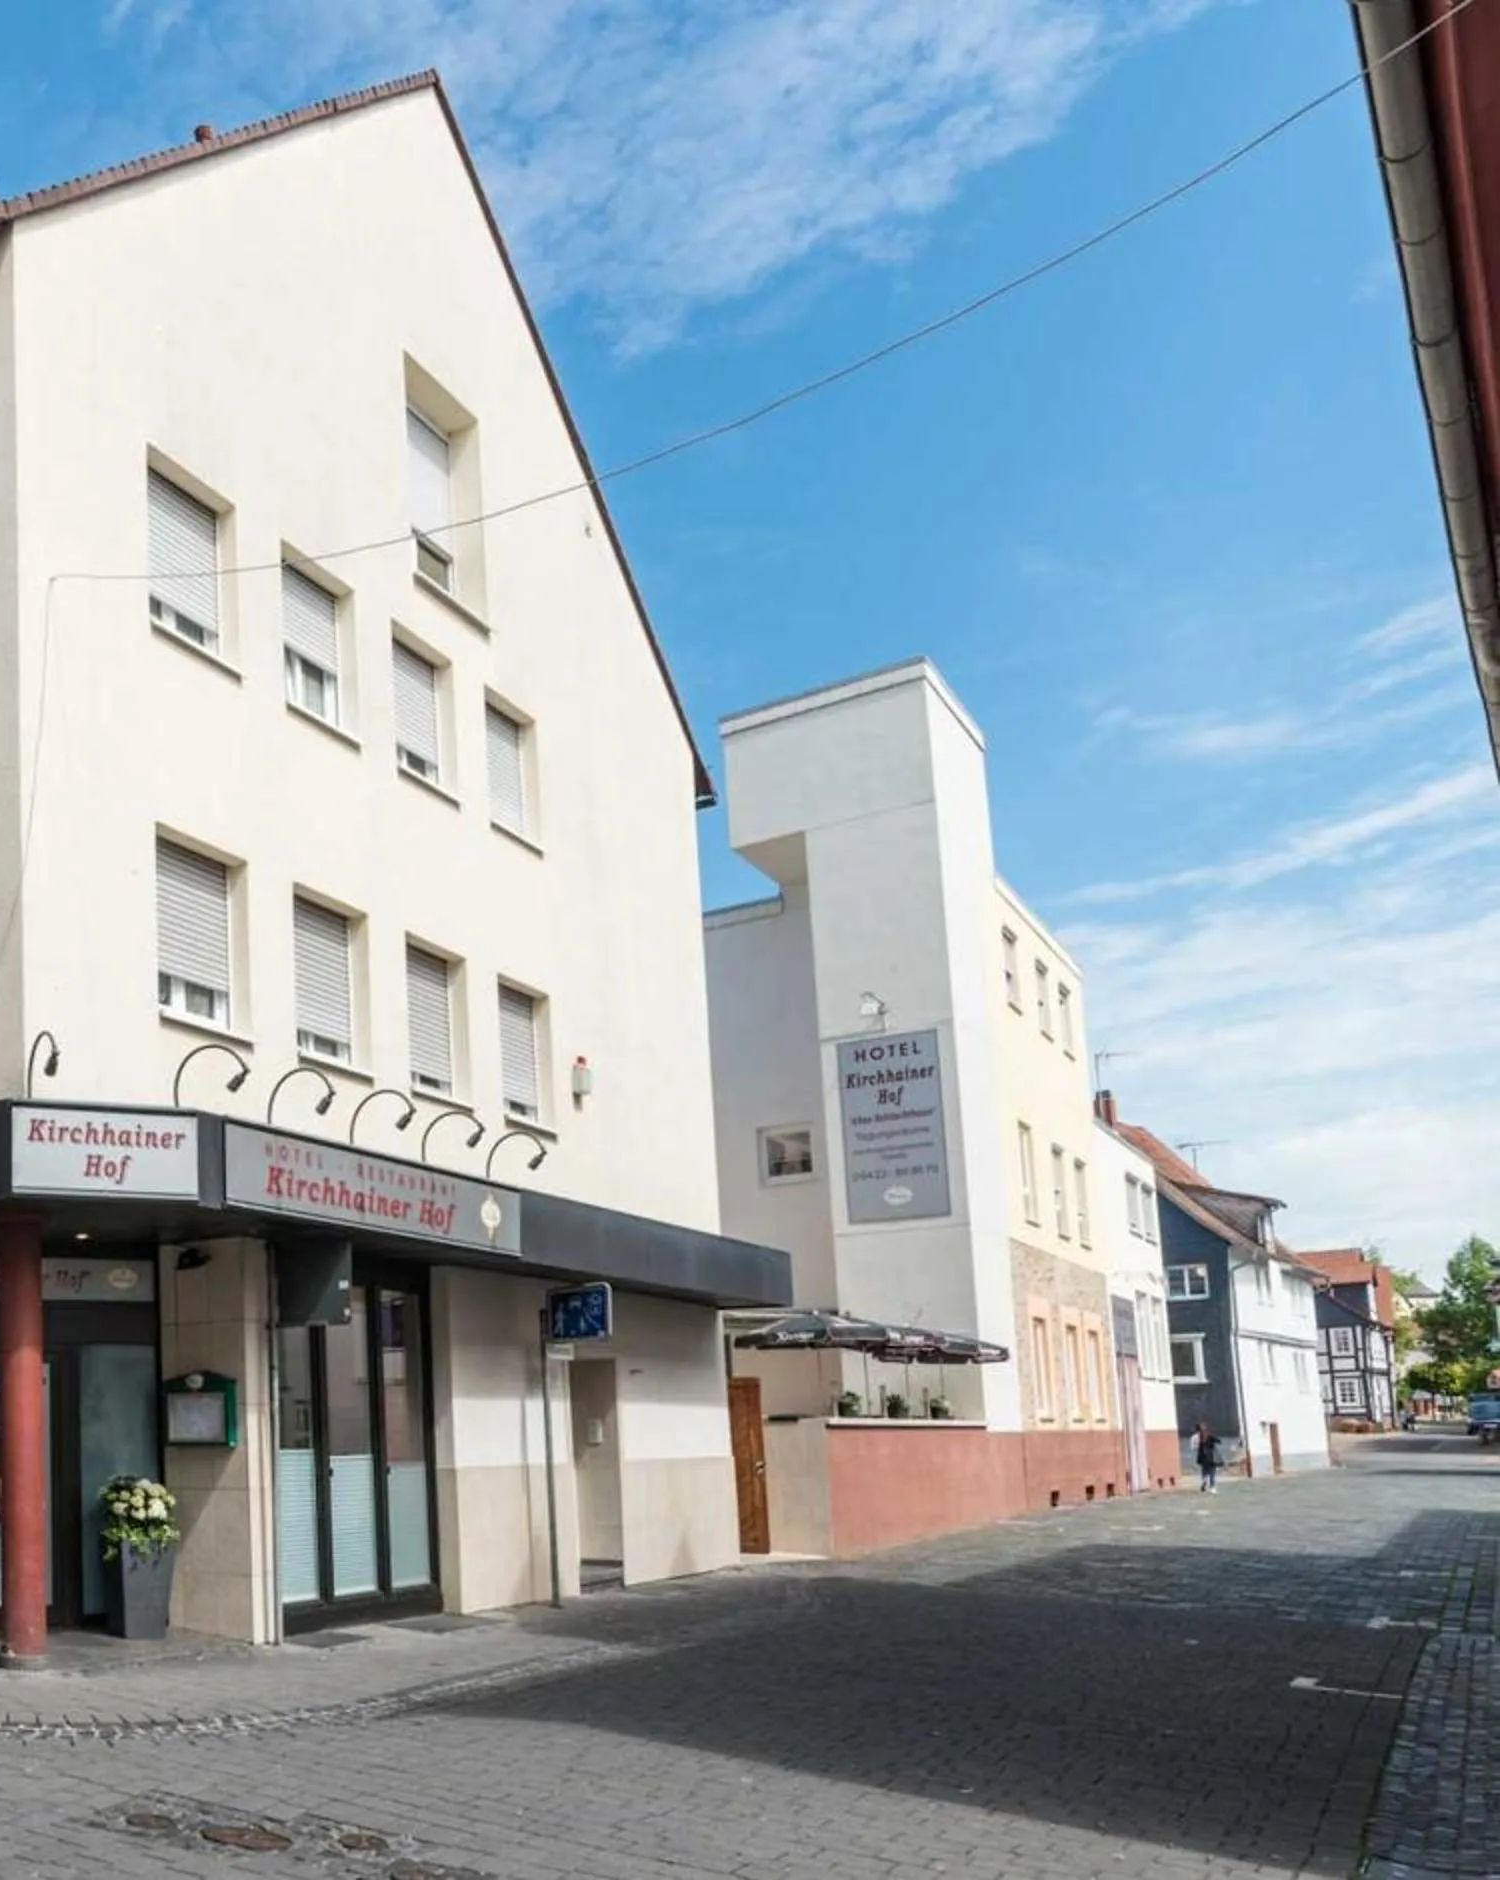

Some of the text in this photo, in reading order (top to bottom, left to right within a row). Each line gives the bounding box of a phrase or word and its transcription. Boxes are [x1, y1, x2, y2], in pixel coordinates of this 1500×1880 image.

[854, 1040, 921, 1063] HOTEL
[846, 1064, 934, 1089] Kirchhainer
[877, 1086, 904, 1106] Hof
[27, 1118, 187, 1150] Kirchhainer
[84, 1153, 132, 1185] Hof
[264, 1141, 323, 1170] HOTEL
[357, 1162, 457, 1197] RESTAURANT
[266, 1166, 457, 1235] Kirchhainer Hof
